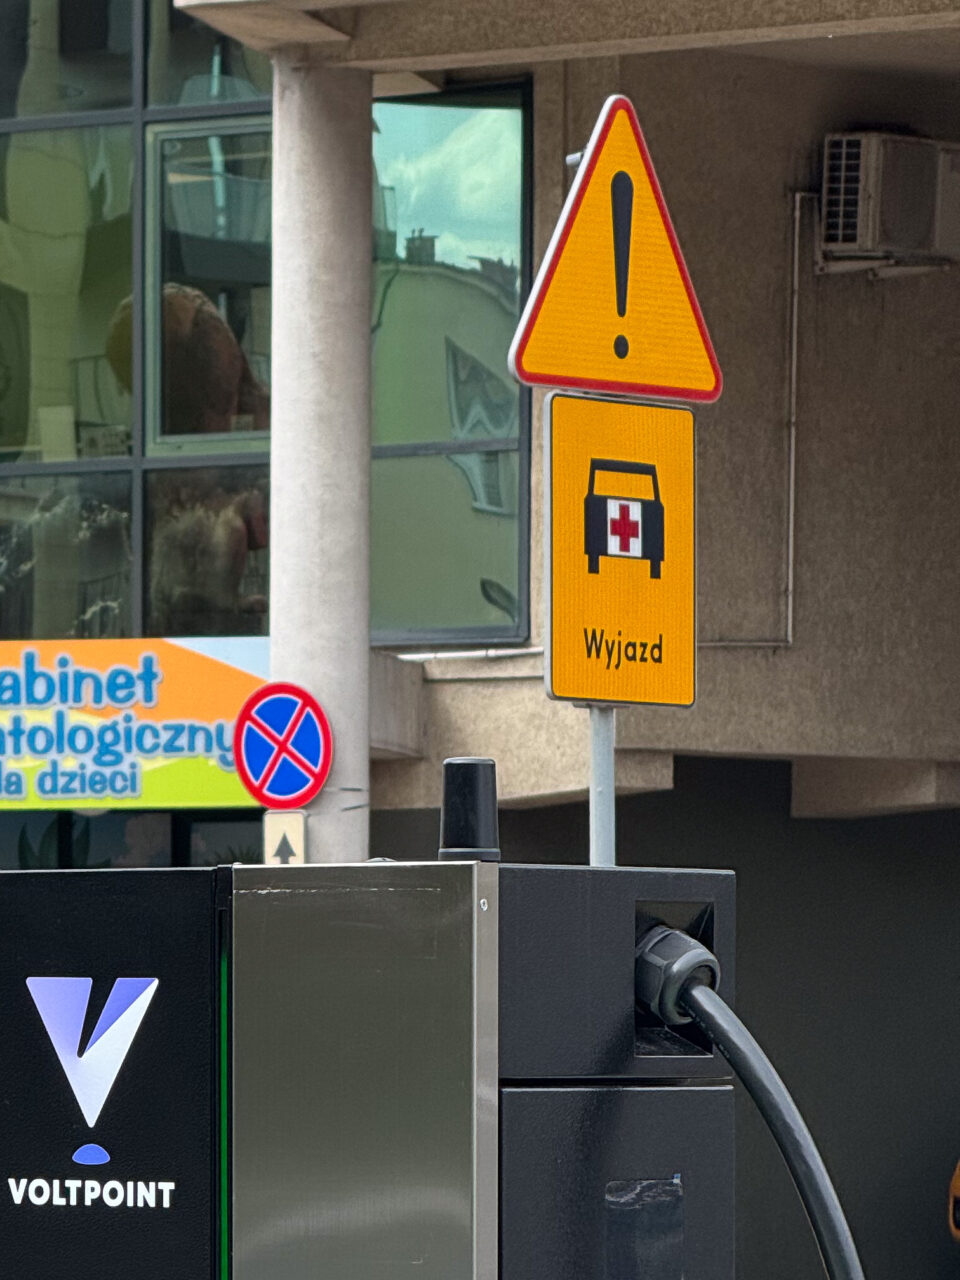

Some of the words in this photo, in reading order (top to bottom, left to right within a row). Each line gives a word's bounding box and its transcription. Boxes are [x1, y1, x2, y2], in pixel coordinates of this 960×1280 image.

[583, 627, 663, 670] Wyjazd
[38, 761, 139, 796] dzieci
[8, 1178, 176, 1208] VOLTPOINT
